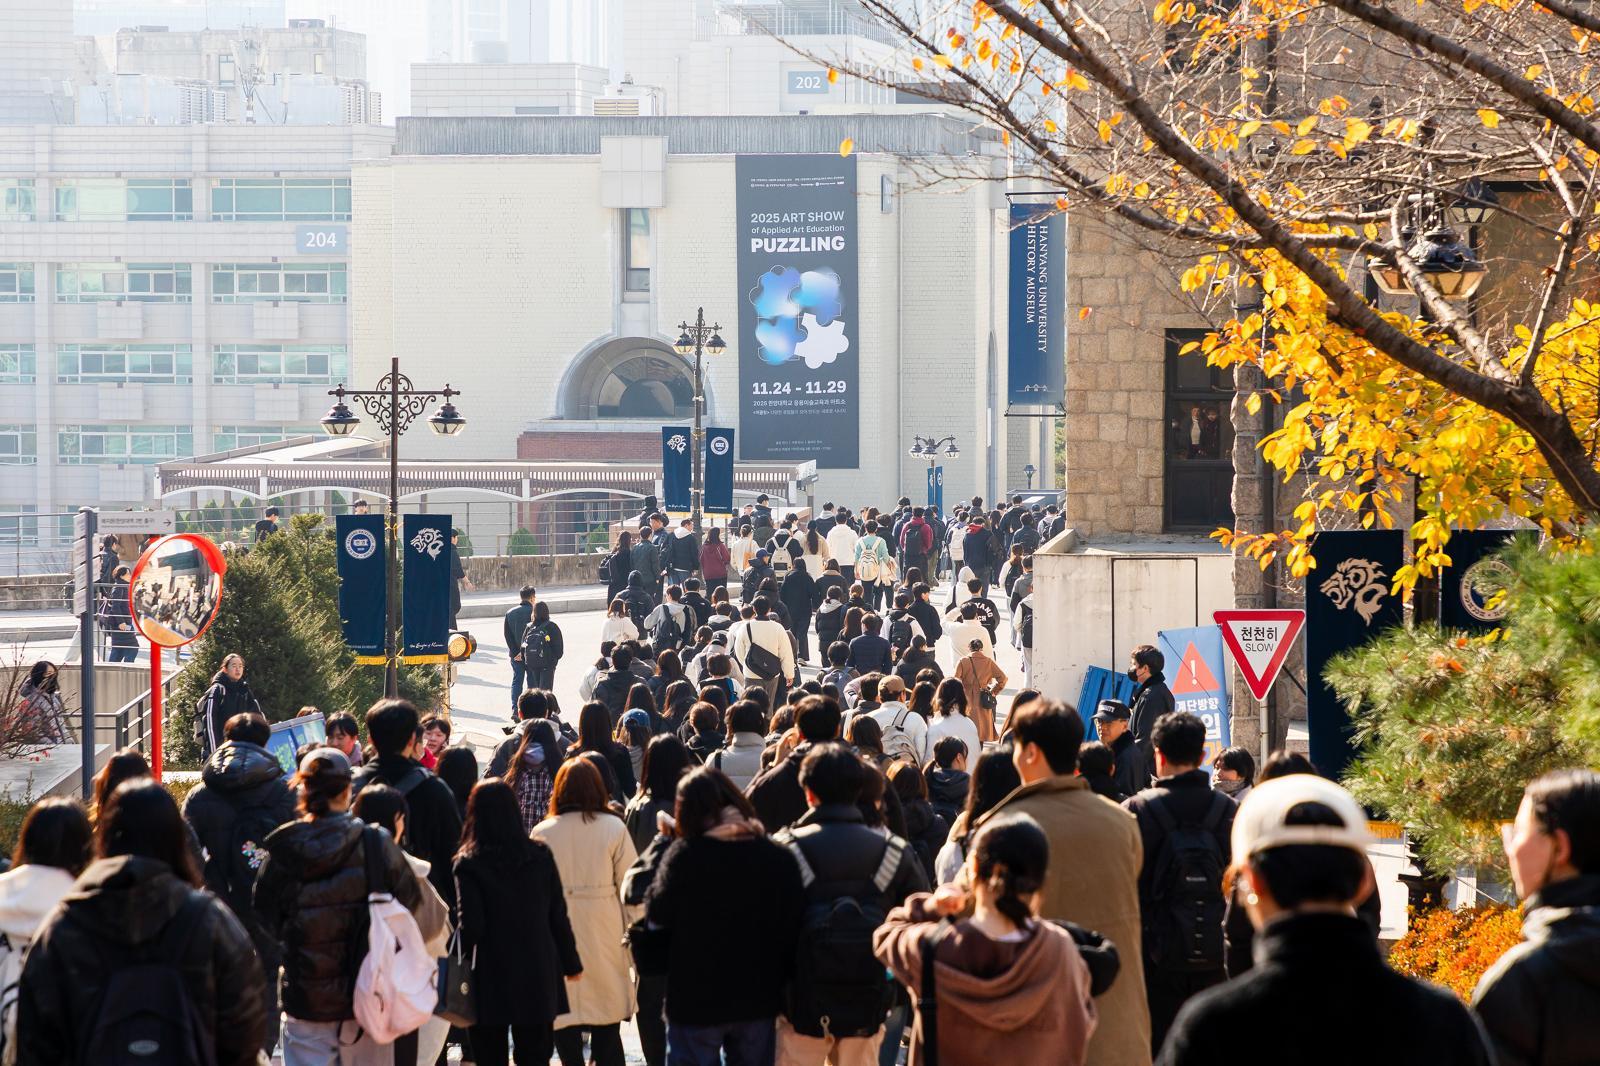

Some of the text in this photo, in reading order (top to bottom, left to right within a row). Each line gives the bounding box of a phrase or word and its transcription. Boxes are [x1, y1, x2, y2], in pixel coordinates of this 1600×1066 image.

[795, 76, 821, 89] 202
[751, 211, 845, 223] 2025 ART SHOW
[751, 224, 845, 235] of Applied Art Education
[305, 231, 337, 248] 204
[751, 236, 846, 253] PUZZLING
[1026, 225, 1037, 324] HISTORY MUSEUM
[1038, 225, 1048, 353] HANYANG UNIVERSITY
[752, 382, 792, 395] 11.24
[805, 380, 847, 394] 11.29
[1241, 627, 1278, 642] 천천히
[1245, 643, 1274, 652] SLOW
[1176, 697, 1219, 712] 계단방향
[1201, 713, 1222, 740] 입
